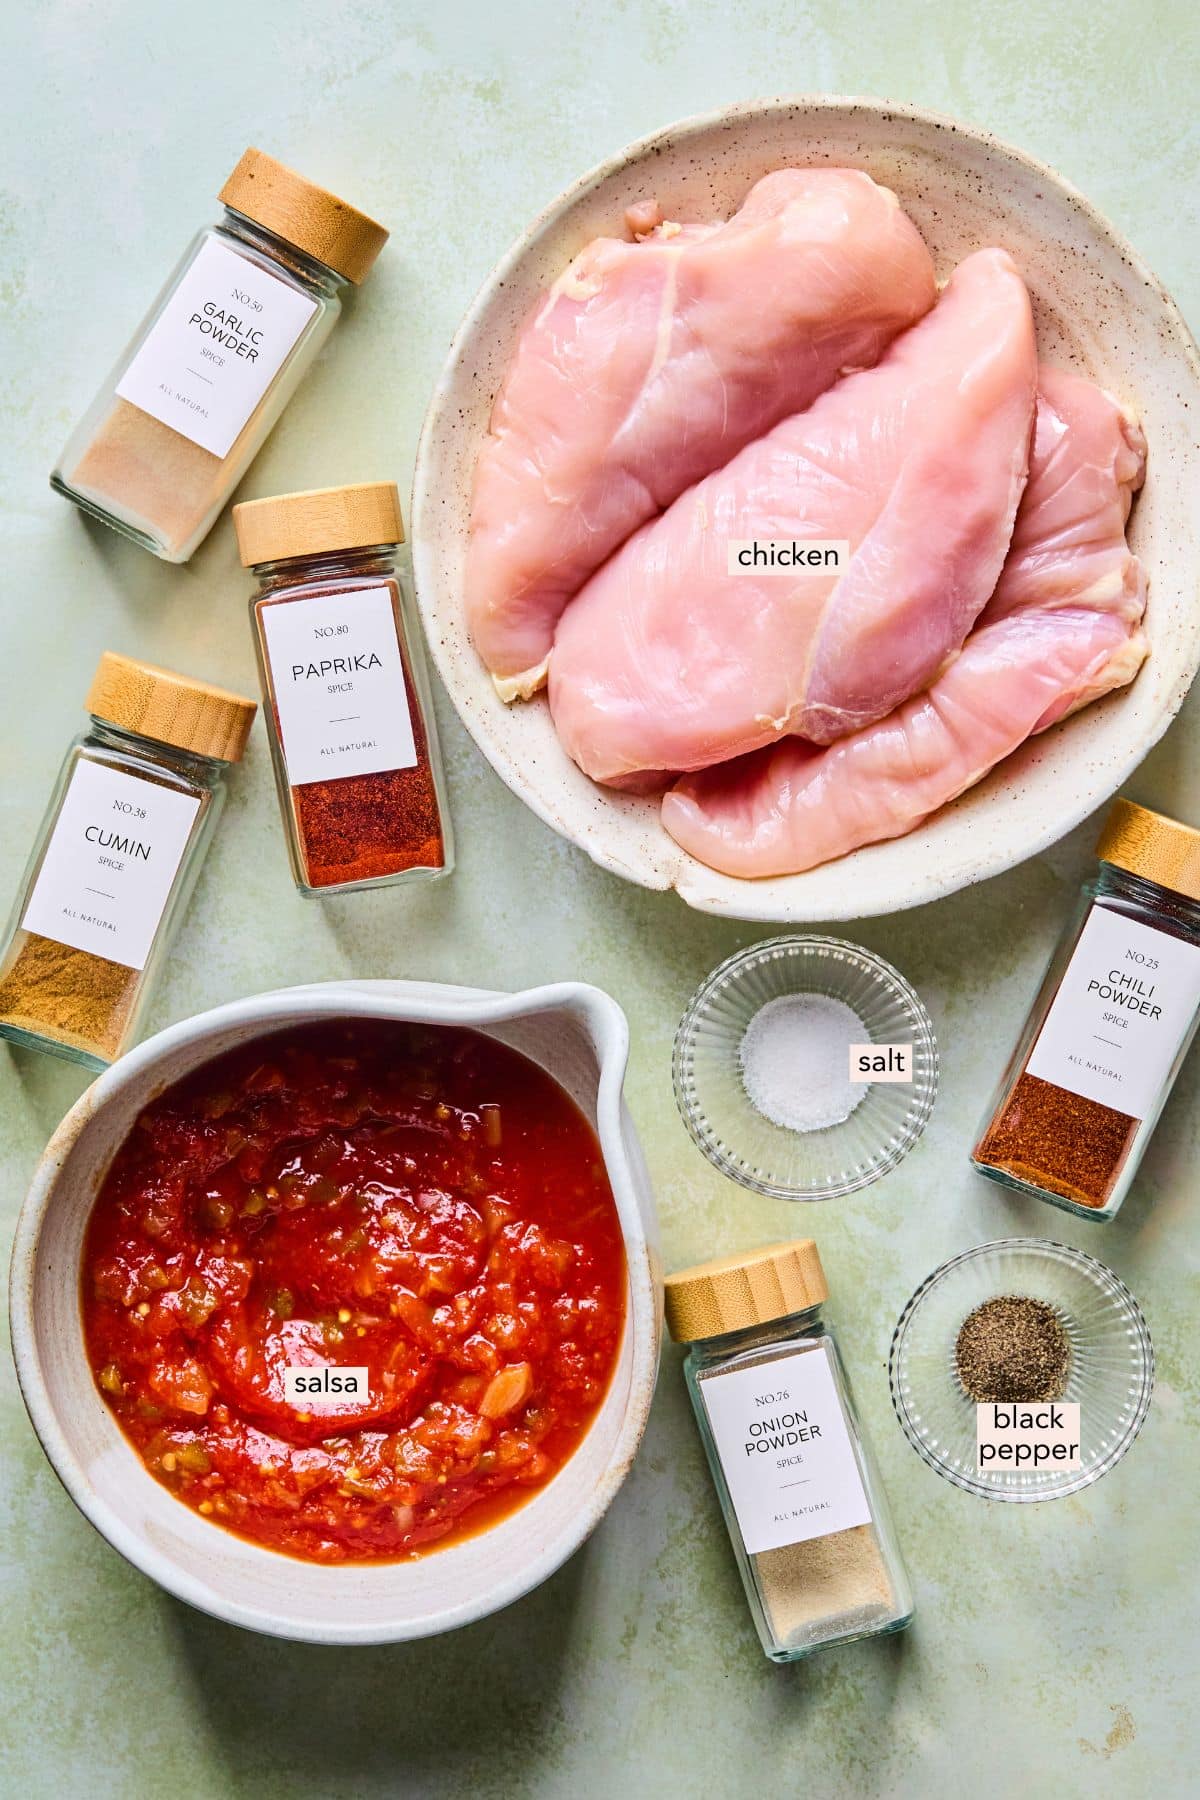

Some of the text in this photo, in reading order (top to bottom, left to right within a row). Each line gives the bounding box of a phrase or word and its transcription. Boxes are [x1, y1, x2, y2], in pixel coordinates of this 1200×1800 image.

[231, 288, 264, 313] NO.50
[203, 302, 265, 345] GARLIC
[188, 313, 260, 364] POWDER
[200, 347, 226, 367] SPICE
[159, 383, 210, 418] ALL NATURAL
[314, 624, 348, 639] NO.80
[291, 653, 383, 682] PAPRIKA
[327, 682, 354, 693] SPICE
[320, 740, 379, 756] ALL NATURAL
[112, 799, 147, 819] NO.38
[84, 825, 152, 861] CUMIN
[97, 855, 125, 871] SPICE
[62, 907, 117, 933] ALL NATURAL
[1125, 948, 1160, 970] NO.25
[1108, 970, 1155, 998] CHILI
[1087, 979, 1162, 1020] POWDER
[1102, 1012, 1128, 1029] SPICE
[1067, 1054, 1123, 1082] ALL NATURAL
[754, 1389, 790, 1408] NO.76
[748, 1410, 808, 1437] ONION
[744, 1425, 822, 1456] POWDER
[776, 1454, 804, 1469] SPICE
[774, 1501, 832, 1523] ALL NATURAL
